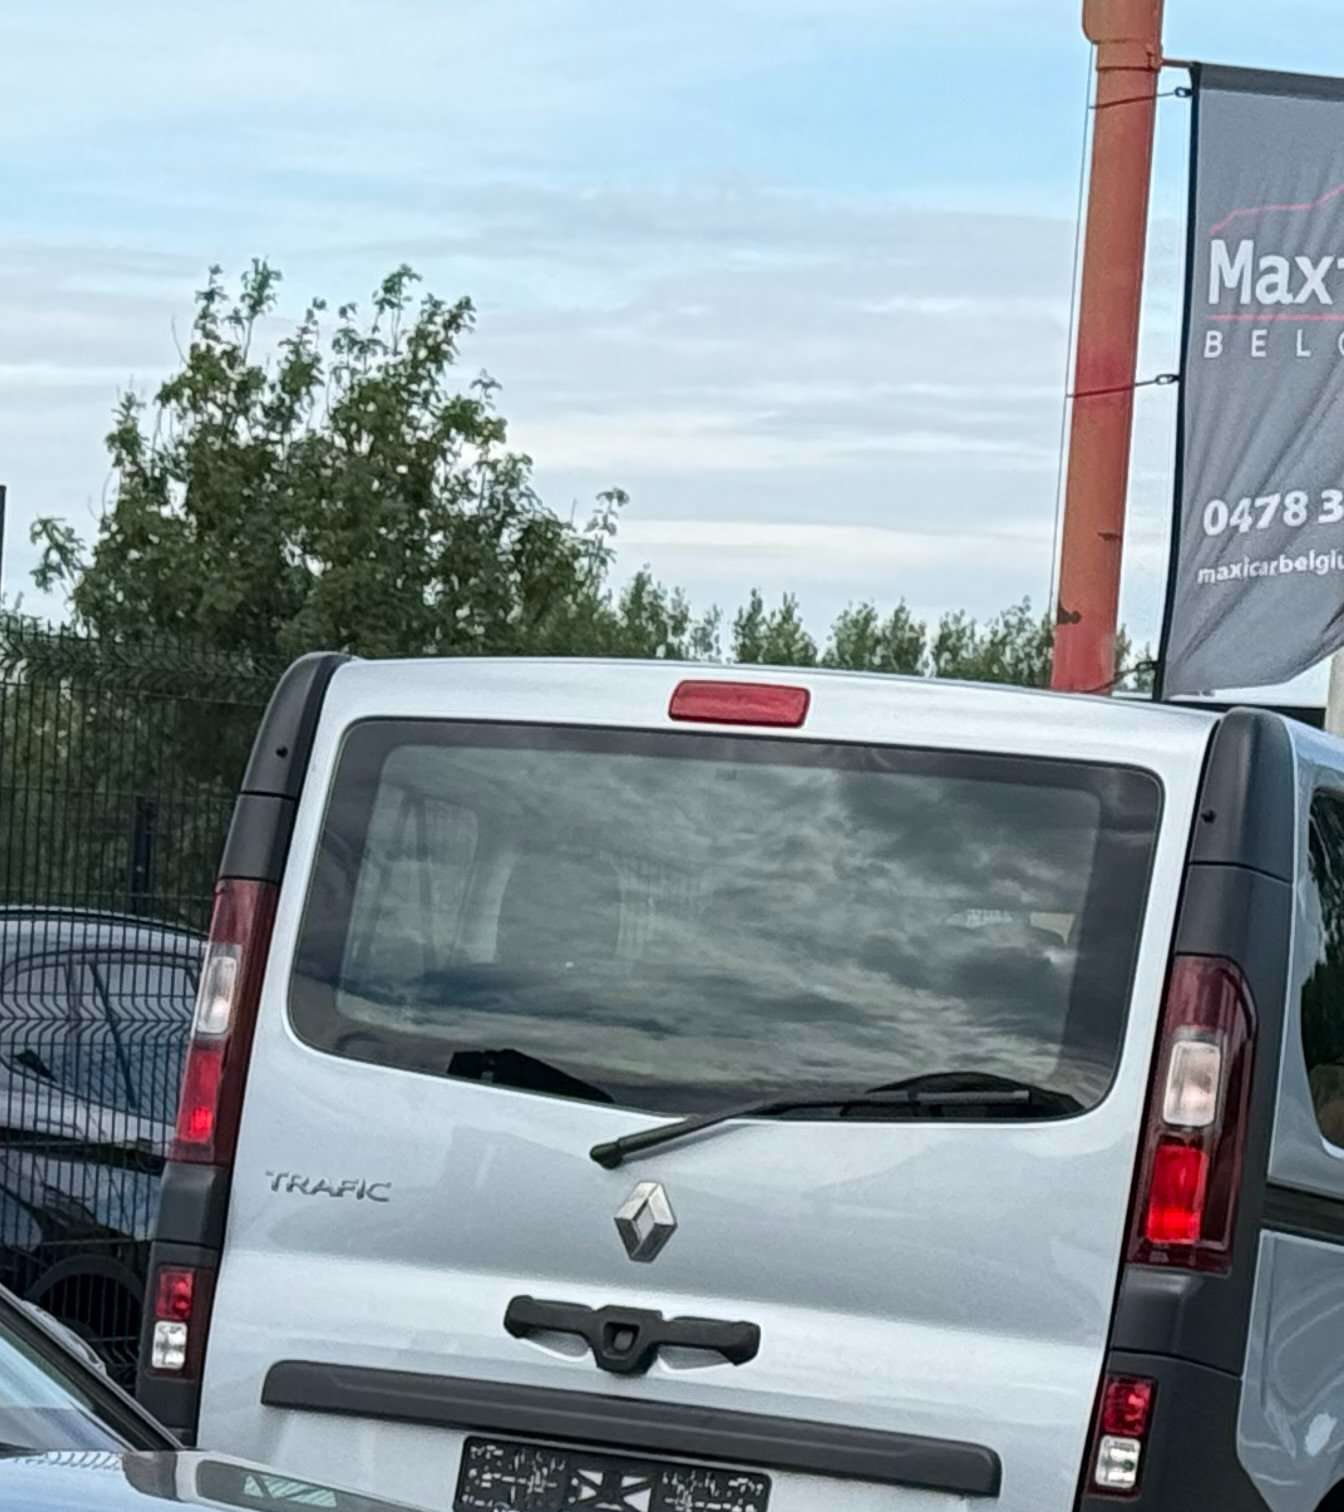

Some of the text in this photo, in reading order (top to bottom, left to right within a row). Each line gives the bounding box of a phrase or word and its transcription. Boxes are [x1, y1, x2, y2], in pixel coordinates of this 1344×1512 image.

[1208, 239, 1344, 305] Max
[1203, 490, 1309, 536] 0478
[265, 1170, 393, 1202] TRAFIC
